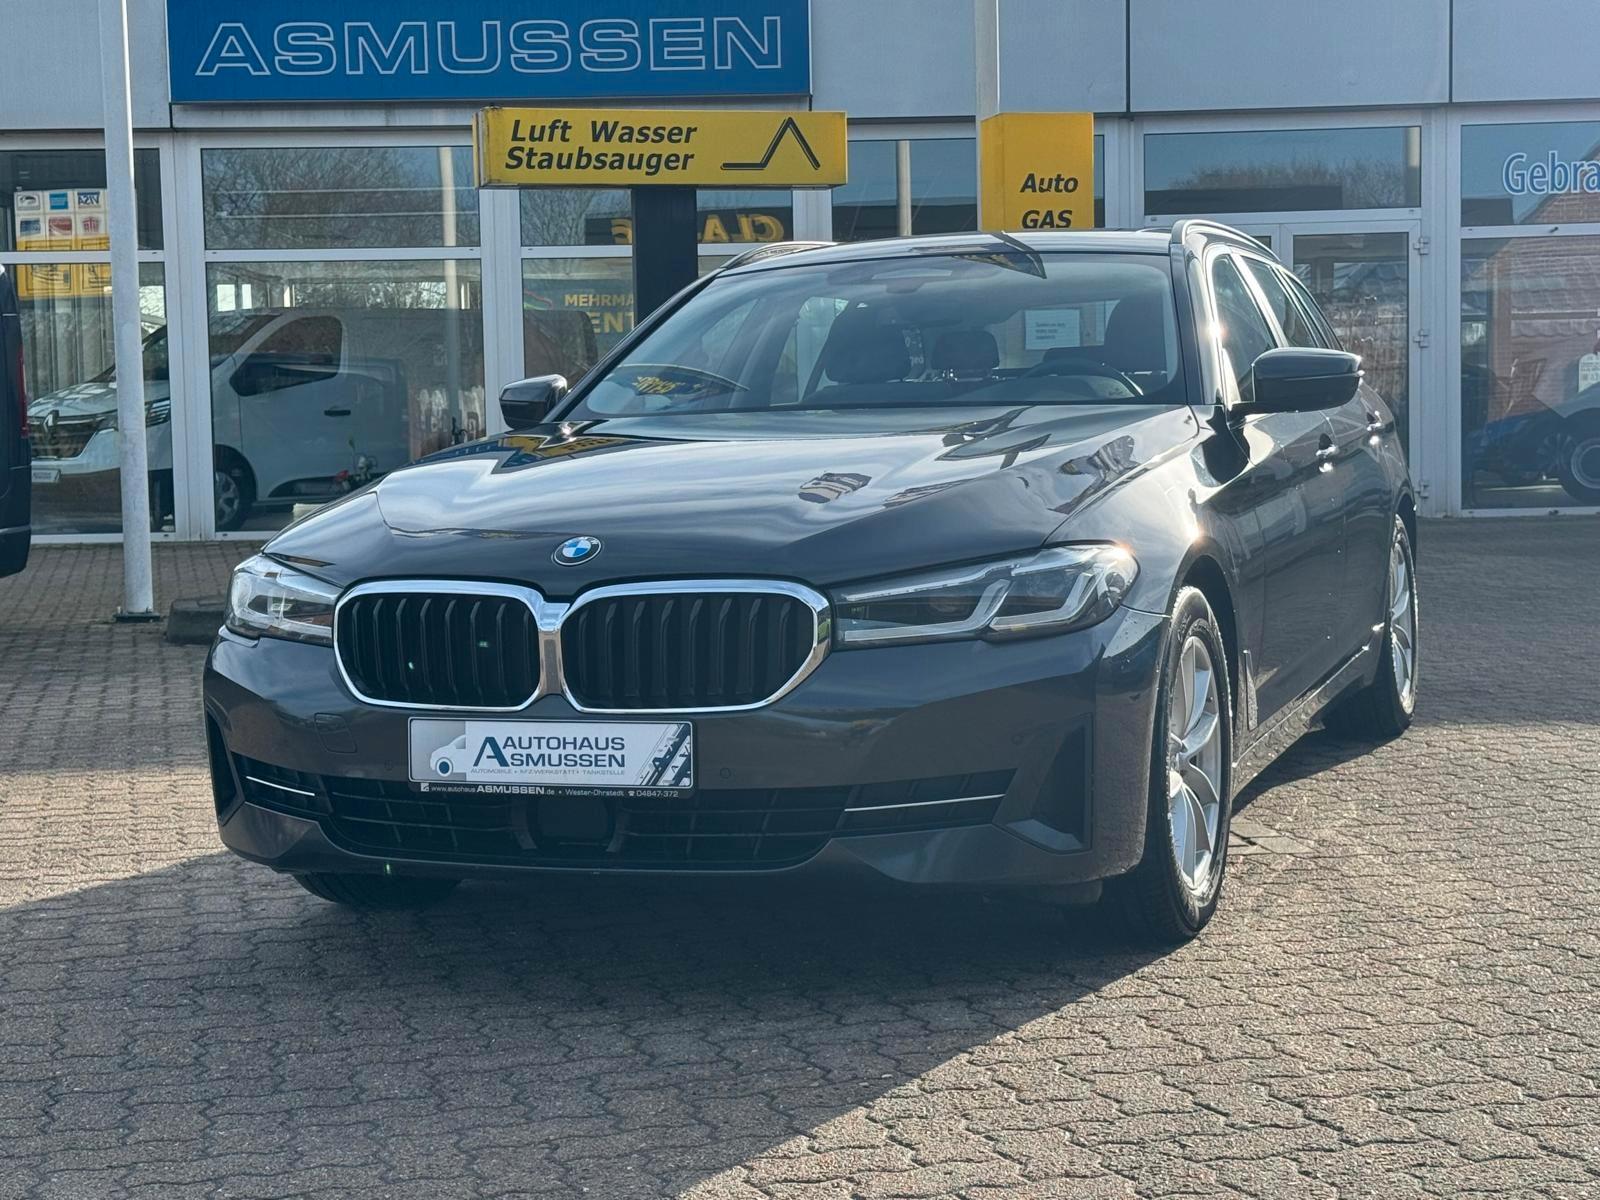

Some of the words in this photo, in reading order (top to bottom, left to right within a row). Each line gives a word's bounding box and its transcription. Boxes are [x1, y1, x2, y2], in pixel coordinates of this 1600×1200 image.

[195, 16, 782, 76] ASMUSSEN
[511, 119, 572, 142] Luft
[590, 120, 698, 144] Wasser
[505, 146, 695, 176] Staubsauger
[1502, 150, 1600, 195] Gebra
[1019, 173, 1079, 193] Auto
[1021, 209, 1073, 228] GAS
[472, 736, 625, 768] ASMUSSEN
[502, 736, 625, 751] AUTOHAUS
